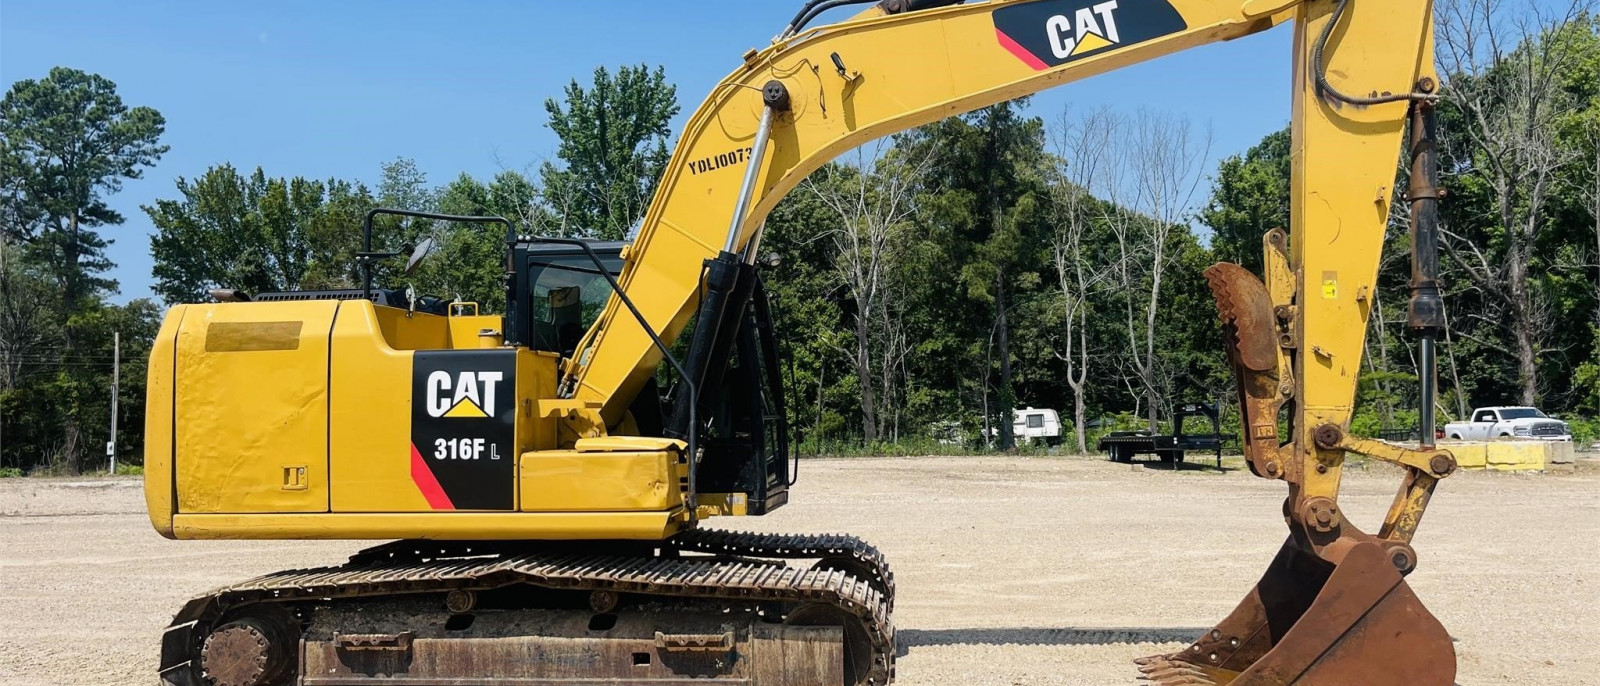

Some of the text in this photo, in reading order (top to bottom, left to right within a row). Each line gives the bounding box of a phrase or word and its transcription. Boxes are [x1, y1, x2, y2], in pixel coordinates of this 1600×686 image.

[1046, 0, 1120, 59] CAT
[426, 370, 503, 418] CAT
[434, 438, 500, 460] 316F L
